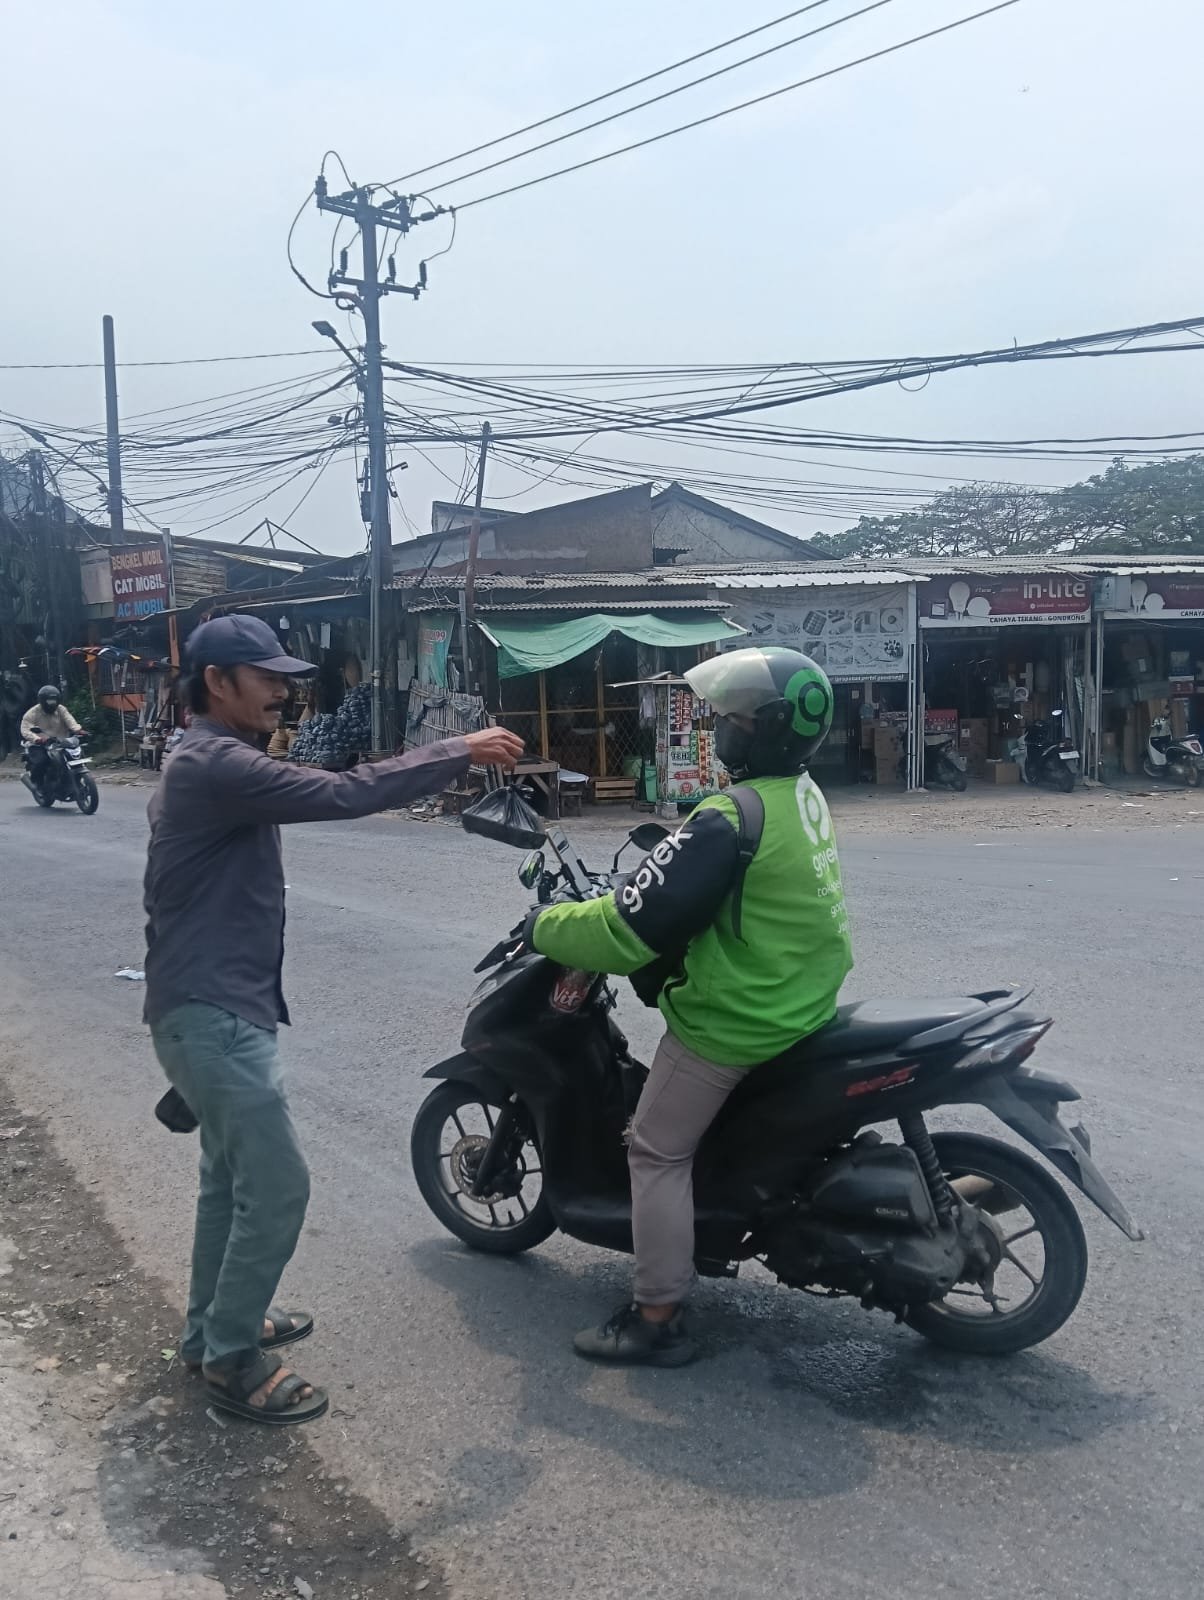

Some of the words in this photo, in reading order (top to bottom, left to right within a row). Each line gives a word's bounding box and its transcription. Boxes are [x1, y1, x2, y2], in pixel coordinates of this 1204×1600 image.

[111, 553, 142, 570] BENGKEL
[142, 550, 163, 566] MOBIL
[114, 577, 134, 594] CAT
[135, 573, 166, 592] MOBIL
[1023, 578, 1086, 599] in-lite
[117, 603, 132, 617] AC
[134, 598, 165, 616] MOBIL
[989, 615, 1017, 623] CAHAYA
[1047, 614, 1086, 622] GONDRONG
[622, 829, 694, 913] gojek
